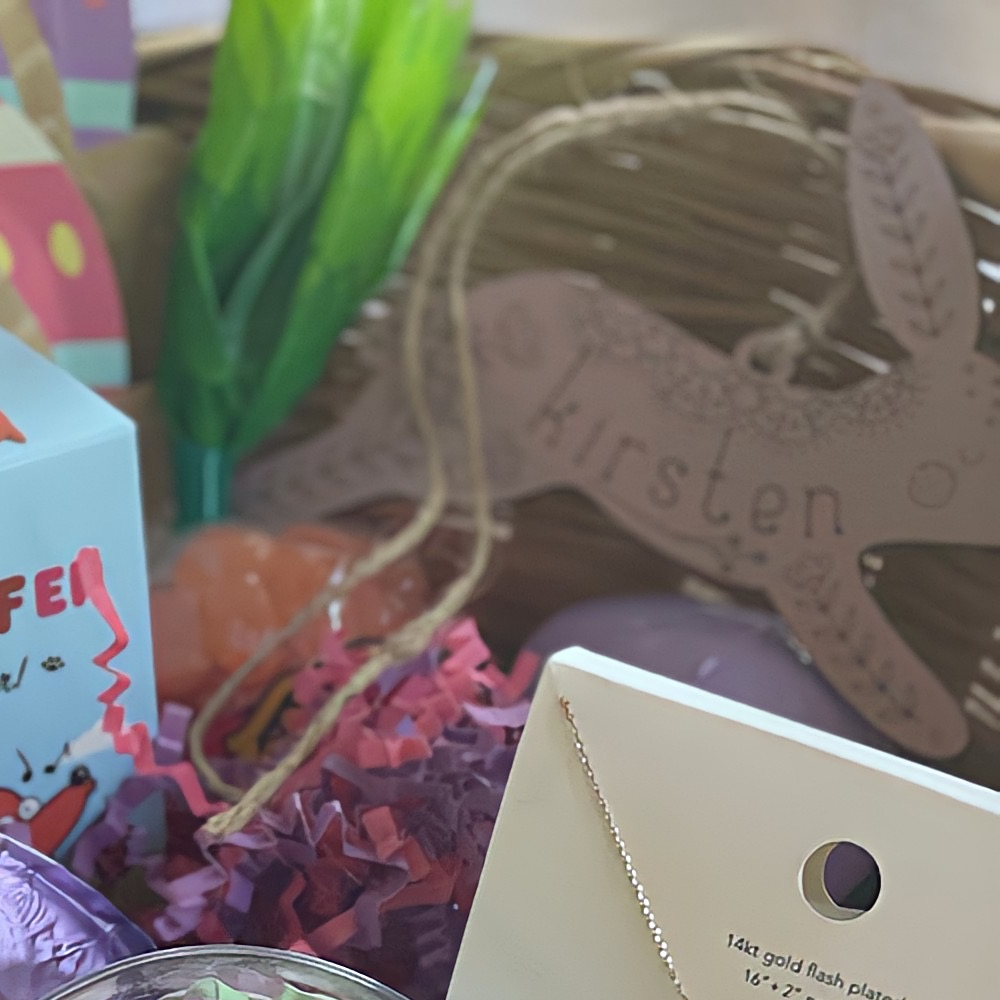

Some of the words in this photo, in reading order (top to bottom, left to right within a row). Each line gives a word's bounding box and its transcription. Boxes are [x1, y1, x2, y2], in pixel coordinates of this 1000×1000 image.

[726, 933, 760, 959] 14kt
[761, 951, 804, 975] gold
[806, 962, 844, 990] flash
